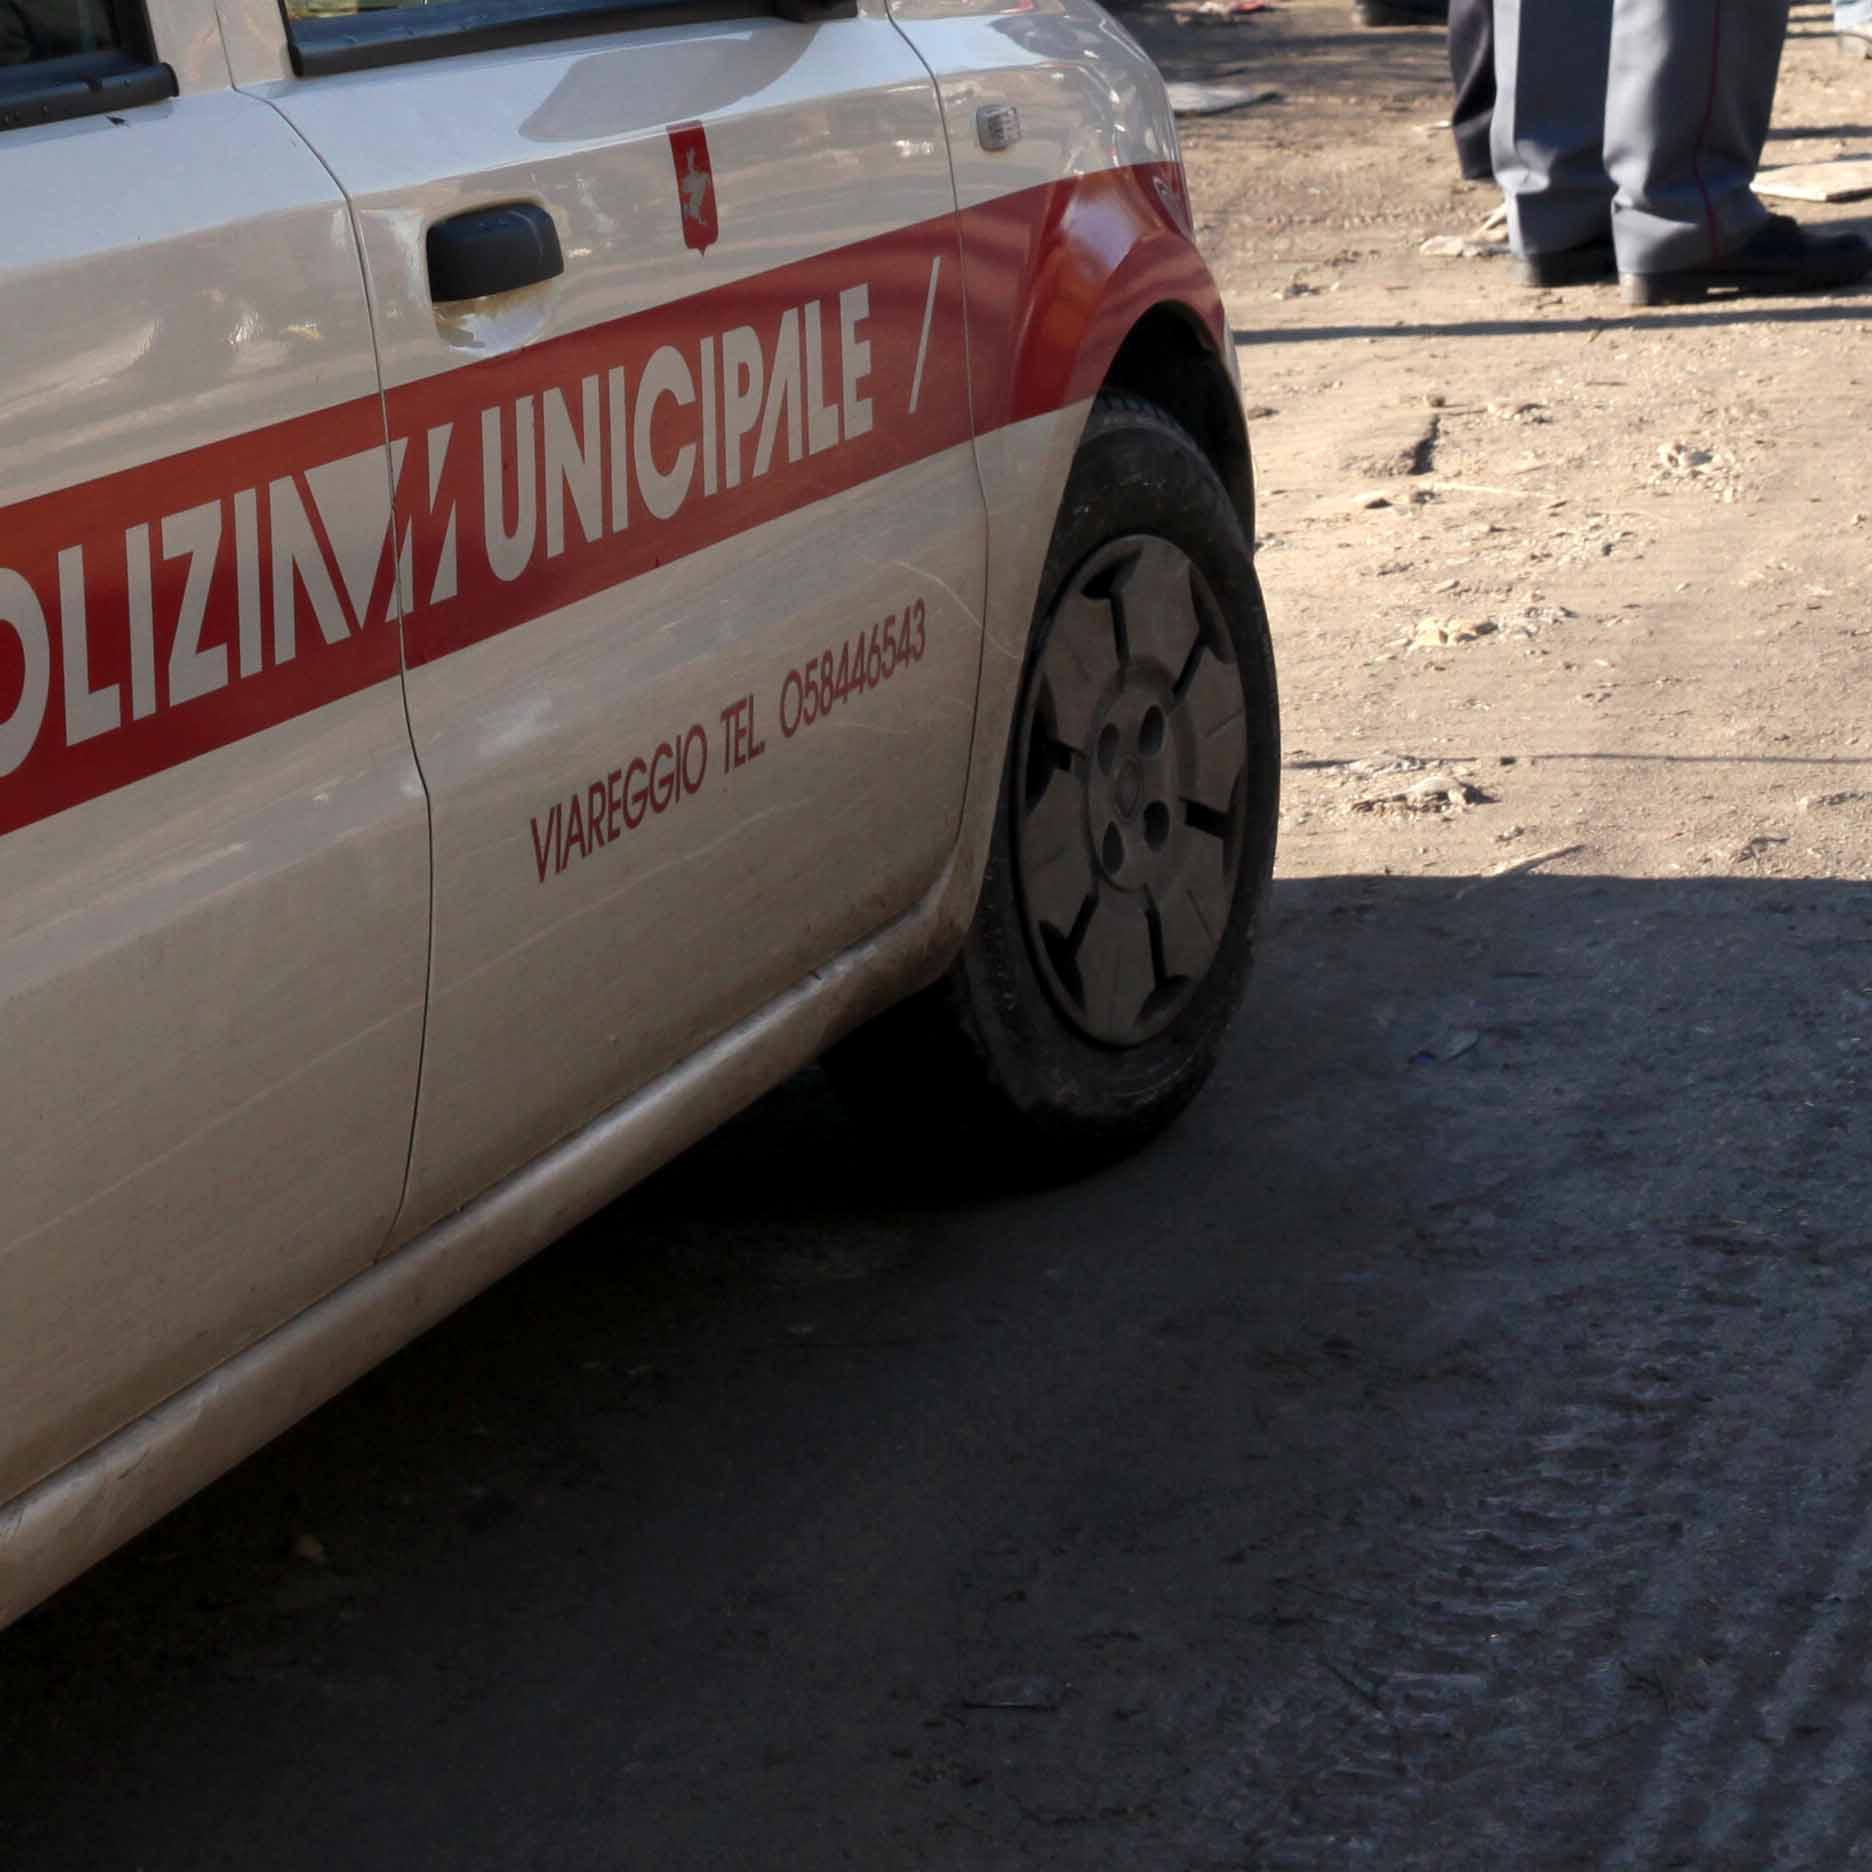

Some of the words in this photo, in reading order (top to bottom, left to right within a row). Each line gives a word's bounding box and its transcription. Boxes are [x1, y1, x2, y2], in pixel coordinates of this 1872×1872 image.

[368, 282, 874, 635] MUNICIPALE
[529, 723, 708, 884] VIAREGGIO
[720, 693, 766, 775] TEL.
[778, 597, 927, 738] 058446543
